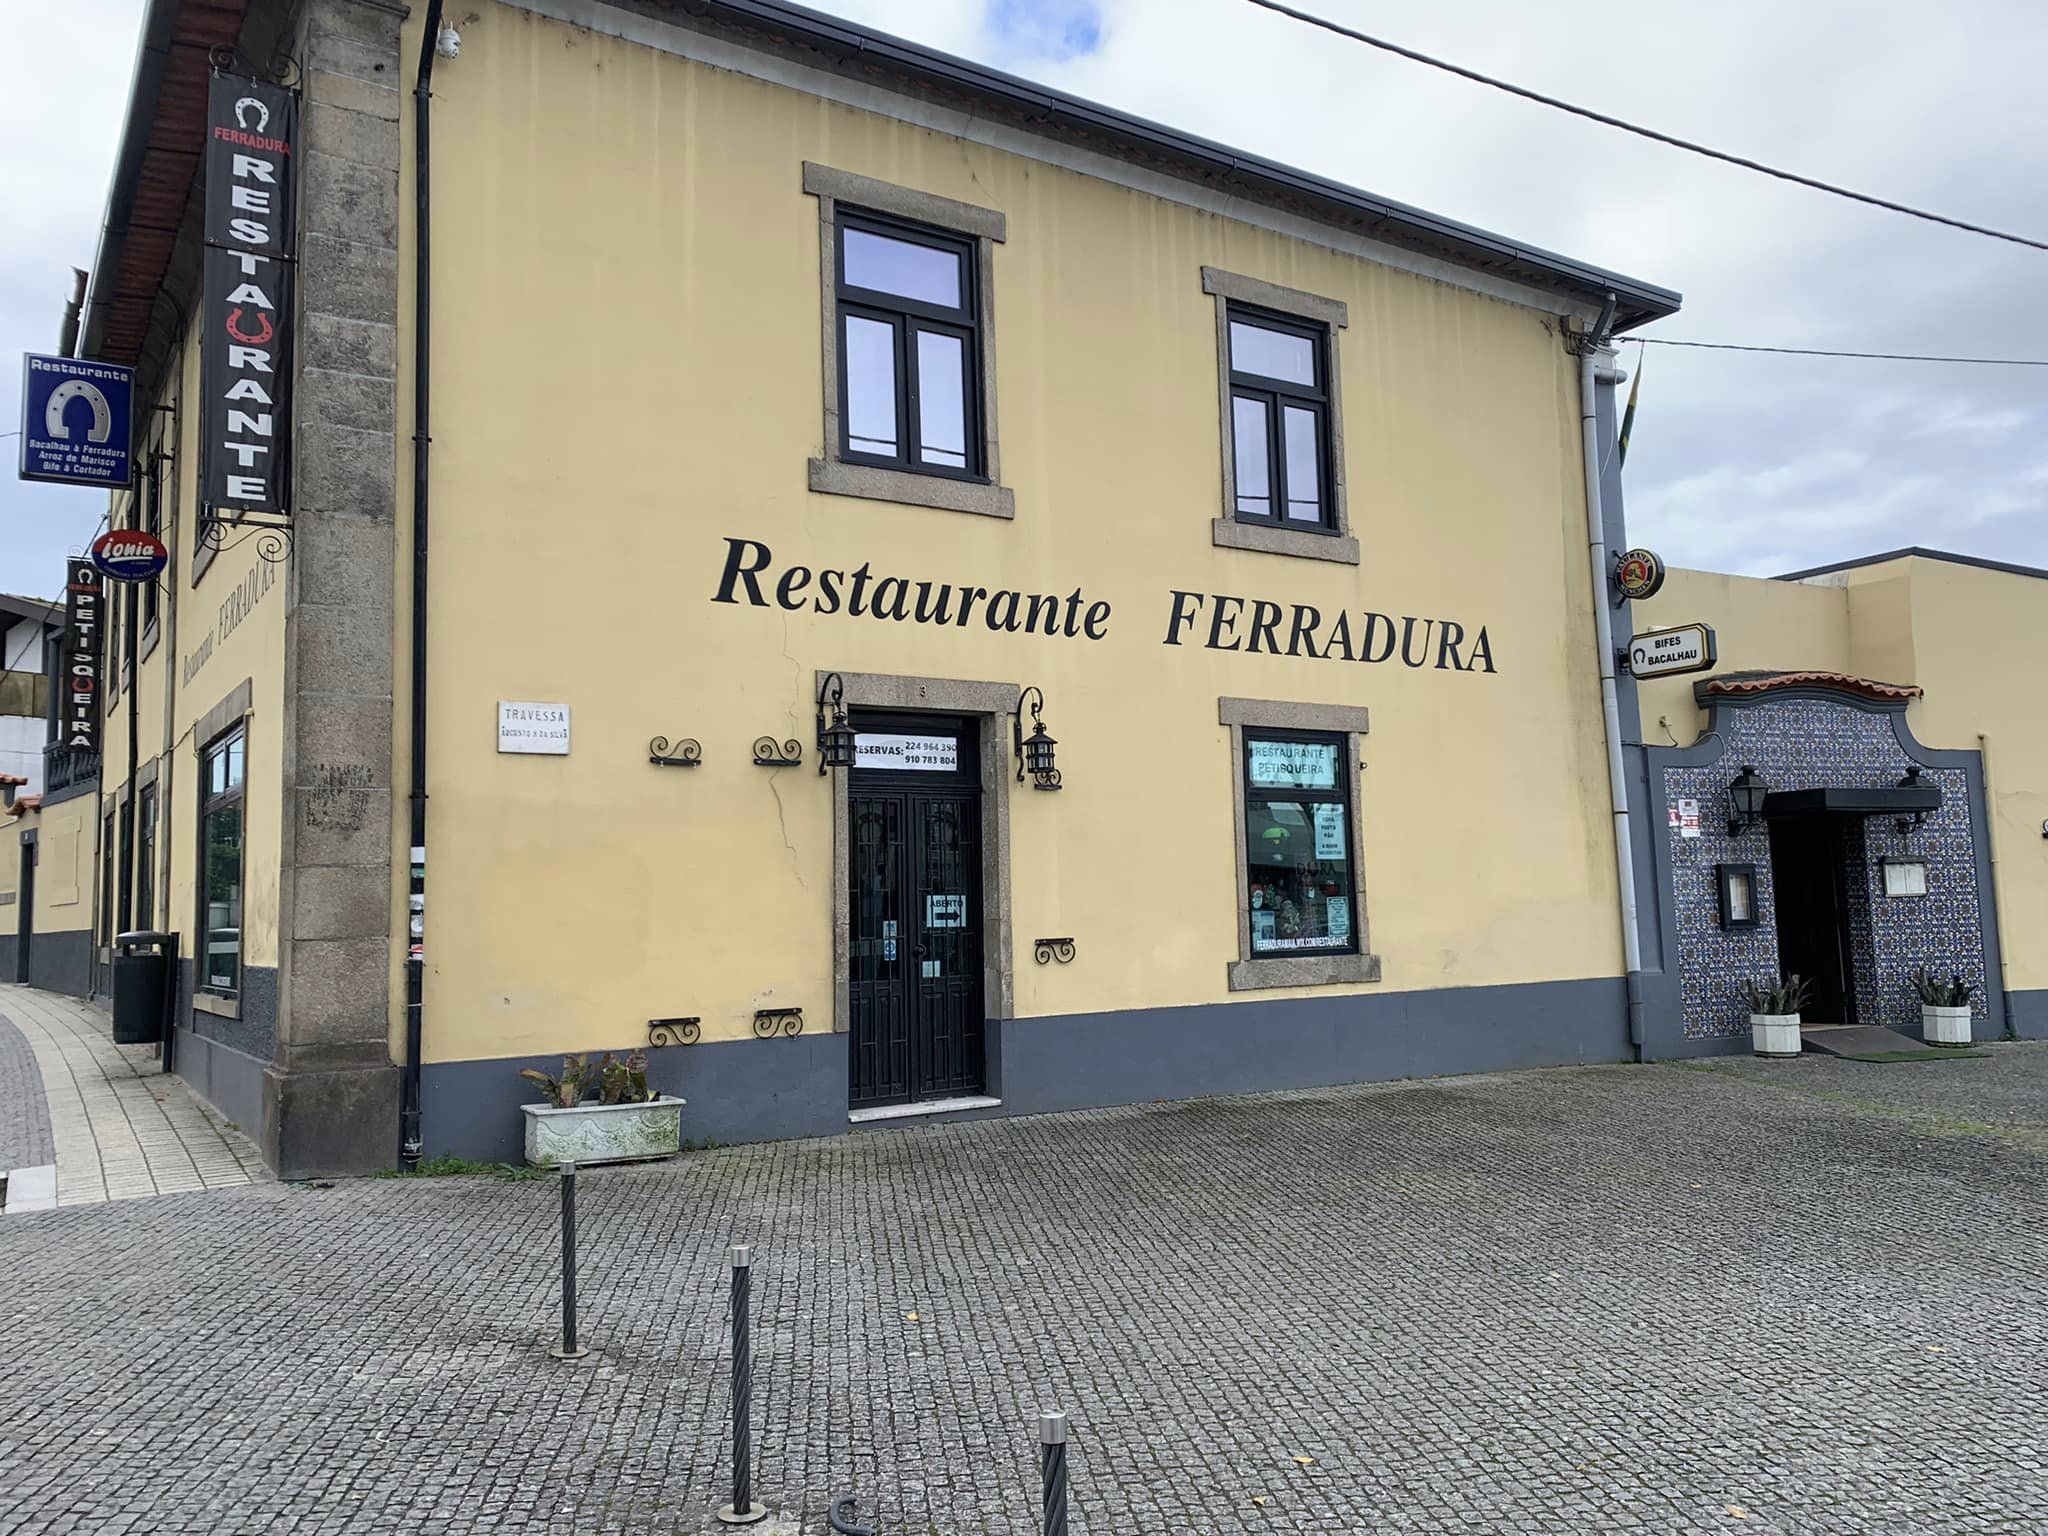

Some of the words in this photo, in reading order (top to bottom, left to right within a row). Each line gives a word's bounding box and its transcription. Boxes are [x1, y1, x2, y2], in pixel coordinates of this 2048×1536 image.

[214, 127, 291, 156] FERRADURA
[31, 359, 129, 381] Restaurante
[29, 439, 70, 451] Bacalhau
[83, 445, 126, 458] Ferradura
[38, 451, 63, 460] Arroz
[66, 454, 77, 462] de
[80, 455, 116, 467] Marisco
[43, 461, 60, 471] Bife
[73, 465, 112, 476] Cortador
[710, 537, 1111, 641] Restaurante
[1162, 590, 1498, 674] FERRADURA
[1655, 636, 1681, 649] BIFES
[1648, 649, 1698, 666] BACALHAU
[920, 686, 927, 698] 3
[505, 708, 564, 722] TRAVESSA
[905, 741, 921, 750] 224
[923, 742, 939, 751] 964
[941, 743, 957, 752] 390
[1255, 746, 1325, 759] RESTAURANTE
[905, 755, 920, 764] 910
[922, 755, 937, 764] 783
[939, 756, 956, 765] 804
[1258, 762, 1324, 775] PETISQUEIRA
[929, 900, 964, 908] ABERTO
